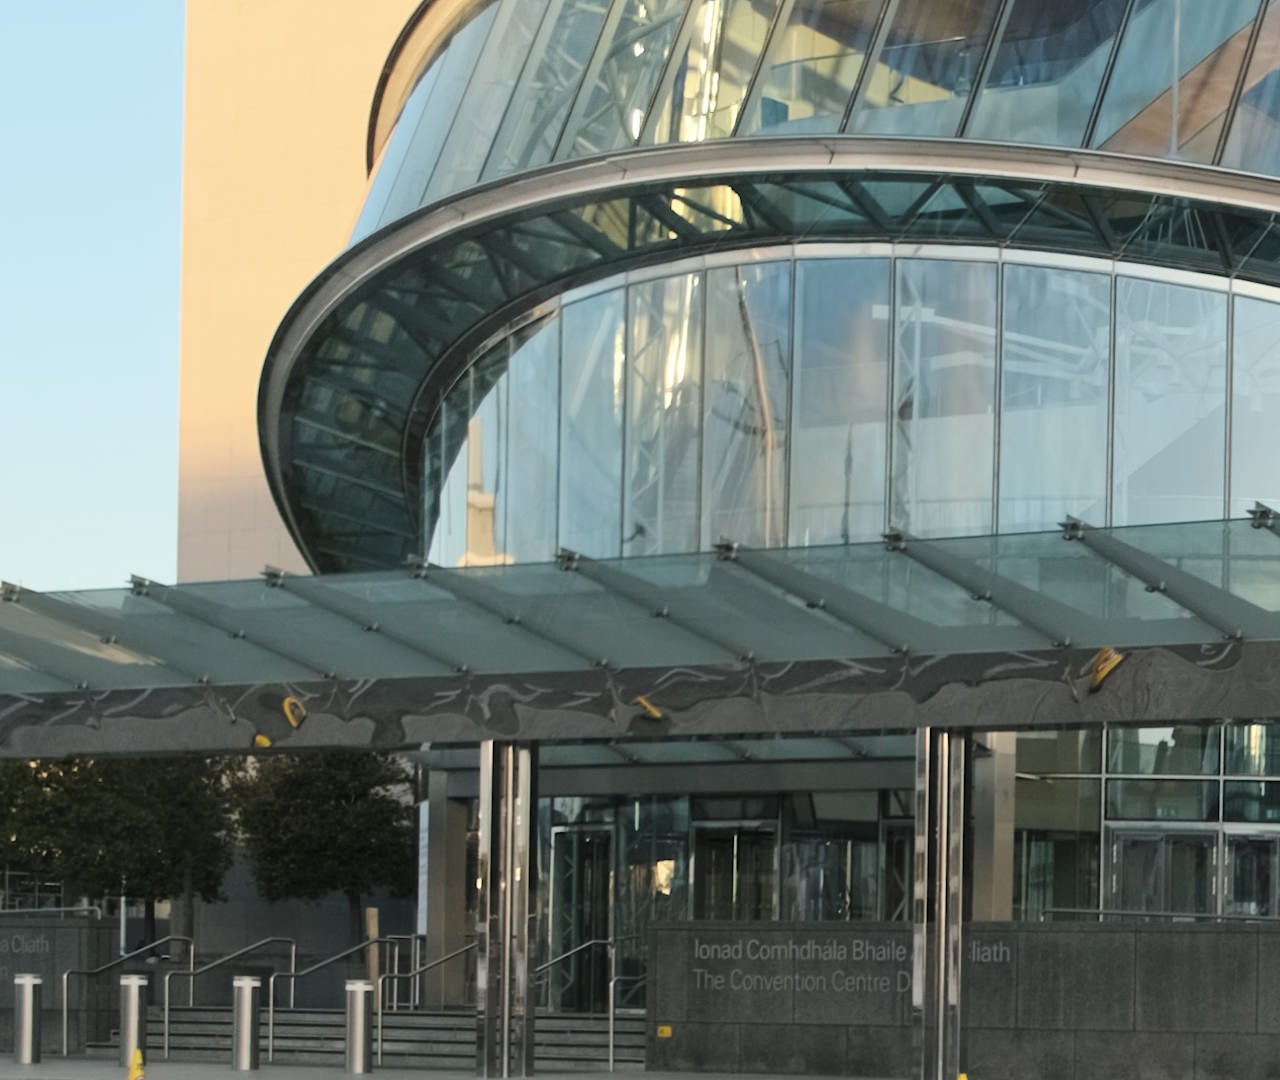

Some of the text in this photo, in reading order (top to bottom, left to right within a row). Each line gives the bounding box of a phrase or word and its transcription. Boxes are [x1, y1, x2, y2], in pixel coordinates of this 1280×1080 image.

[11, 935, 49, 953] Cliath
[694, 939, 742, 960] Ionad
[746, 938, 848, 961] Comhdhála
[853, 939, 906, 961] Bhaile
[968, 940, 1011, 963] liath
[691, 968, 725, 990] The
[730, 968, 827, 992] Convention
[832, 970, 891, 992] Centre
